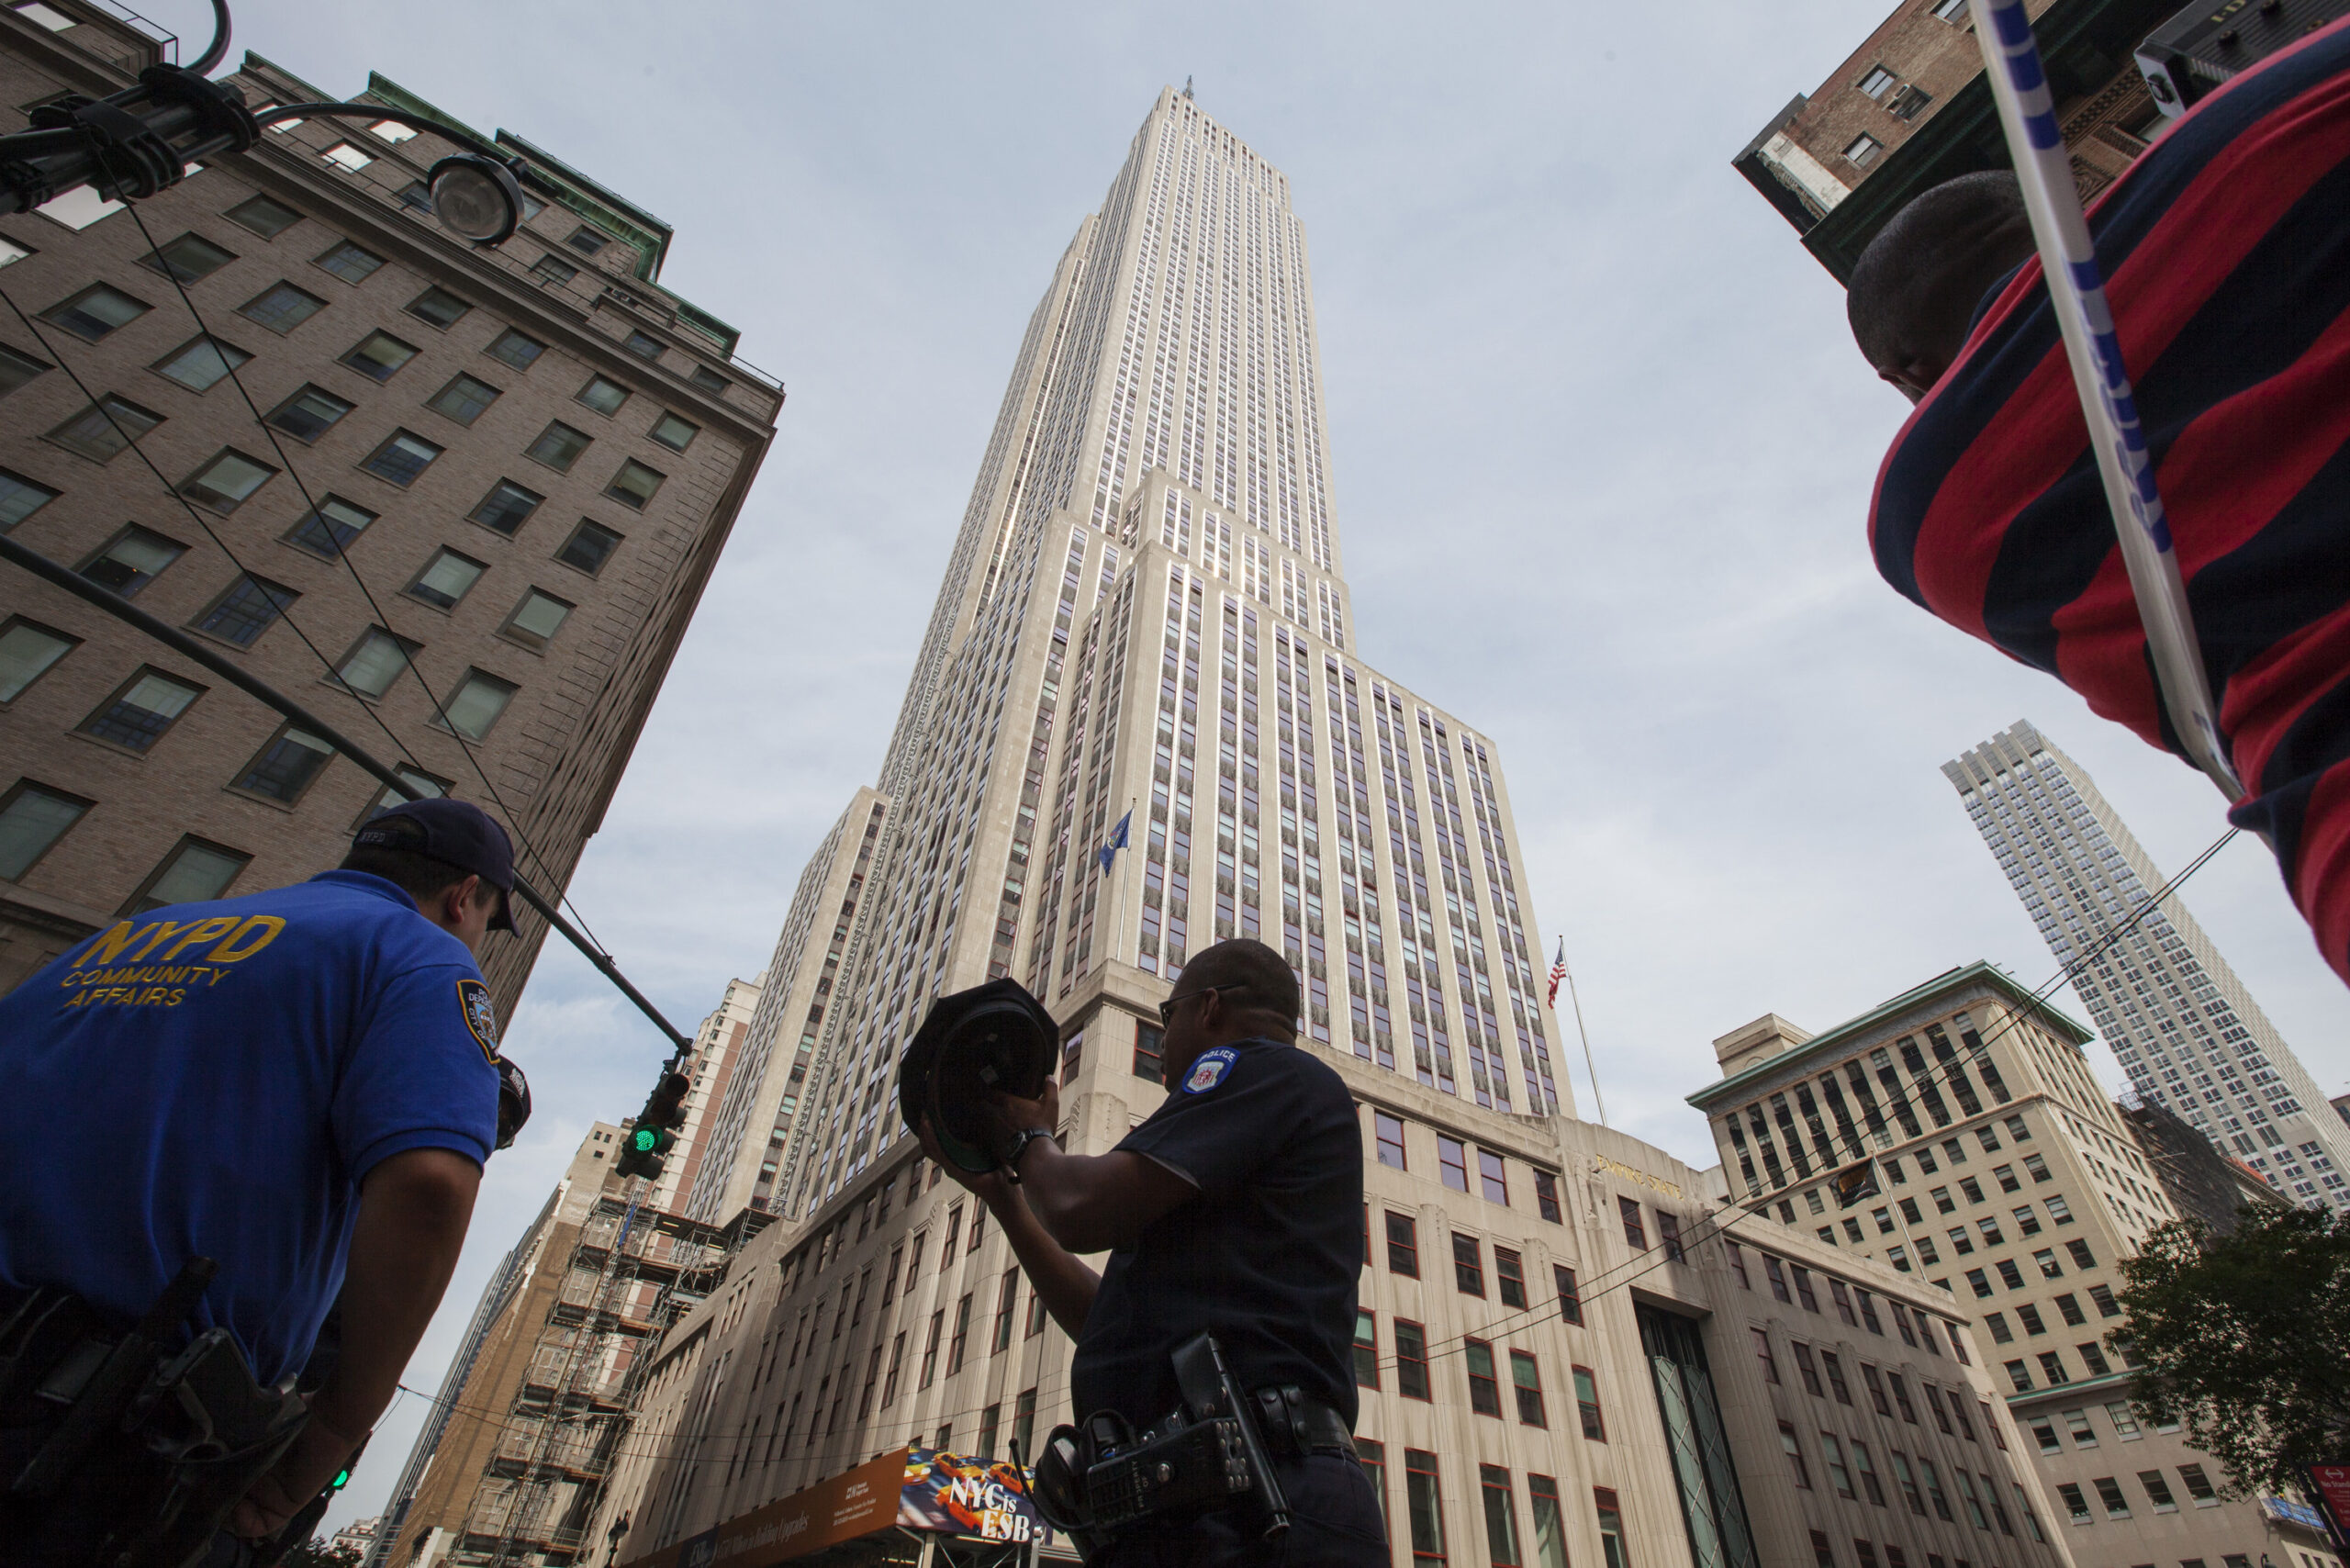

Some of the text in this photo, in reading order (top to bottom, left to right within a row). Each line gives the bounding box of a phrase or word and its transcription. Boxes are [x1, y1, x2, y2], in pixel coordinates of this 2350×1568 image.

[71, 914, 286, 969] NYPD
[61, 967, 231, 988] COMMUNITY
[63, 987, 186, 1008] AFFAIRS
[1198, 1049, 1236, 1063] POLICE
[1596, 1153, 1684, 1202] EMPIRE STATE
[949, 1476, 1017, 1514] NYC is
[980, 1509, 1030, 1542] ESB
